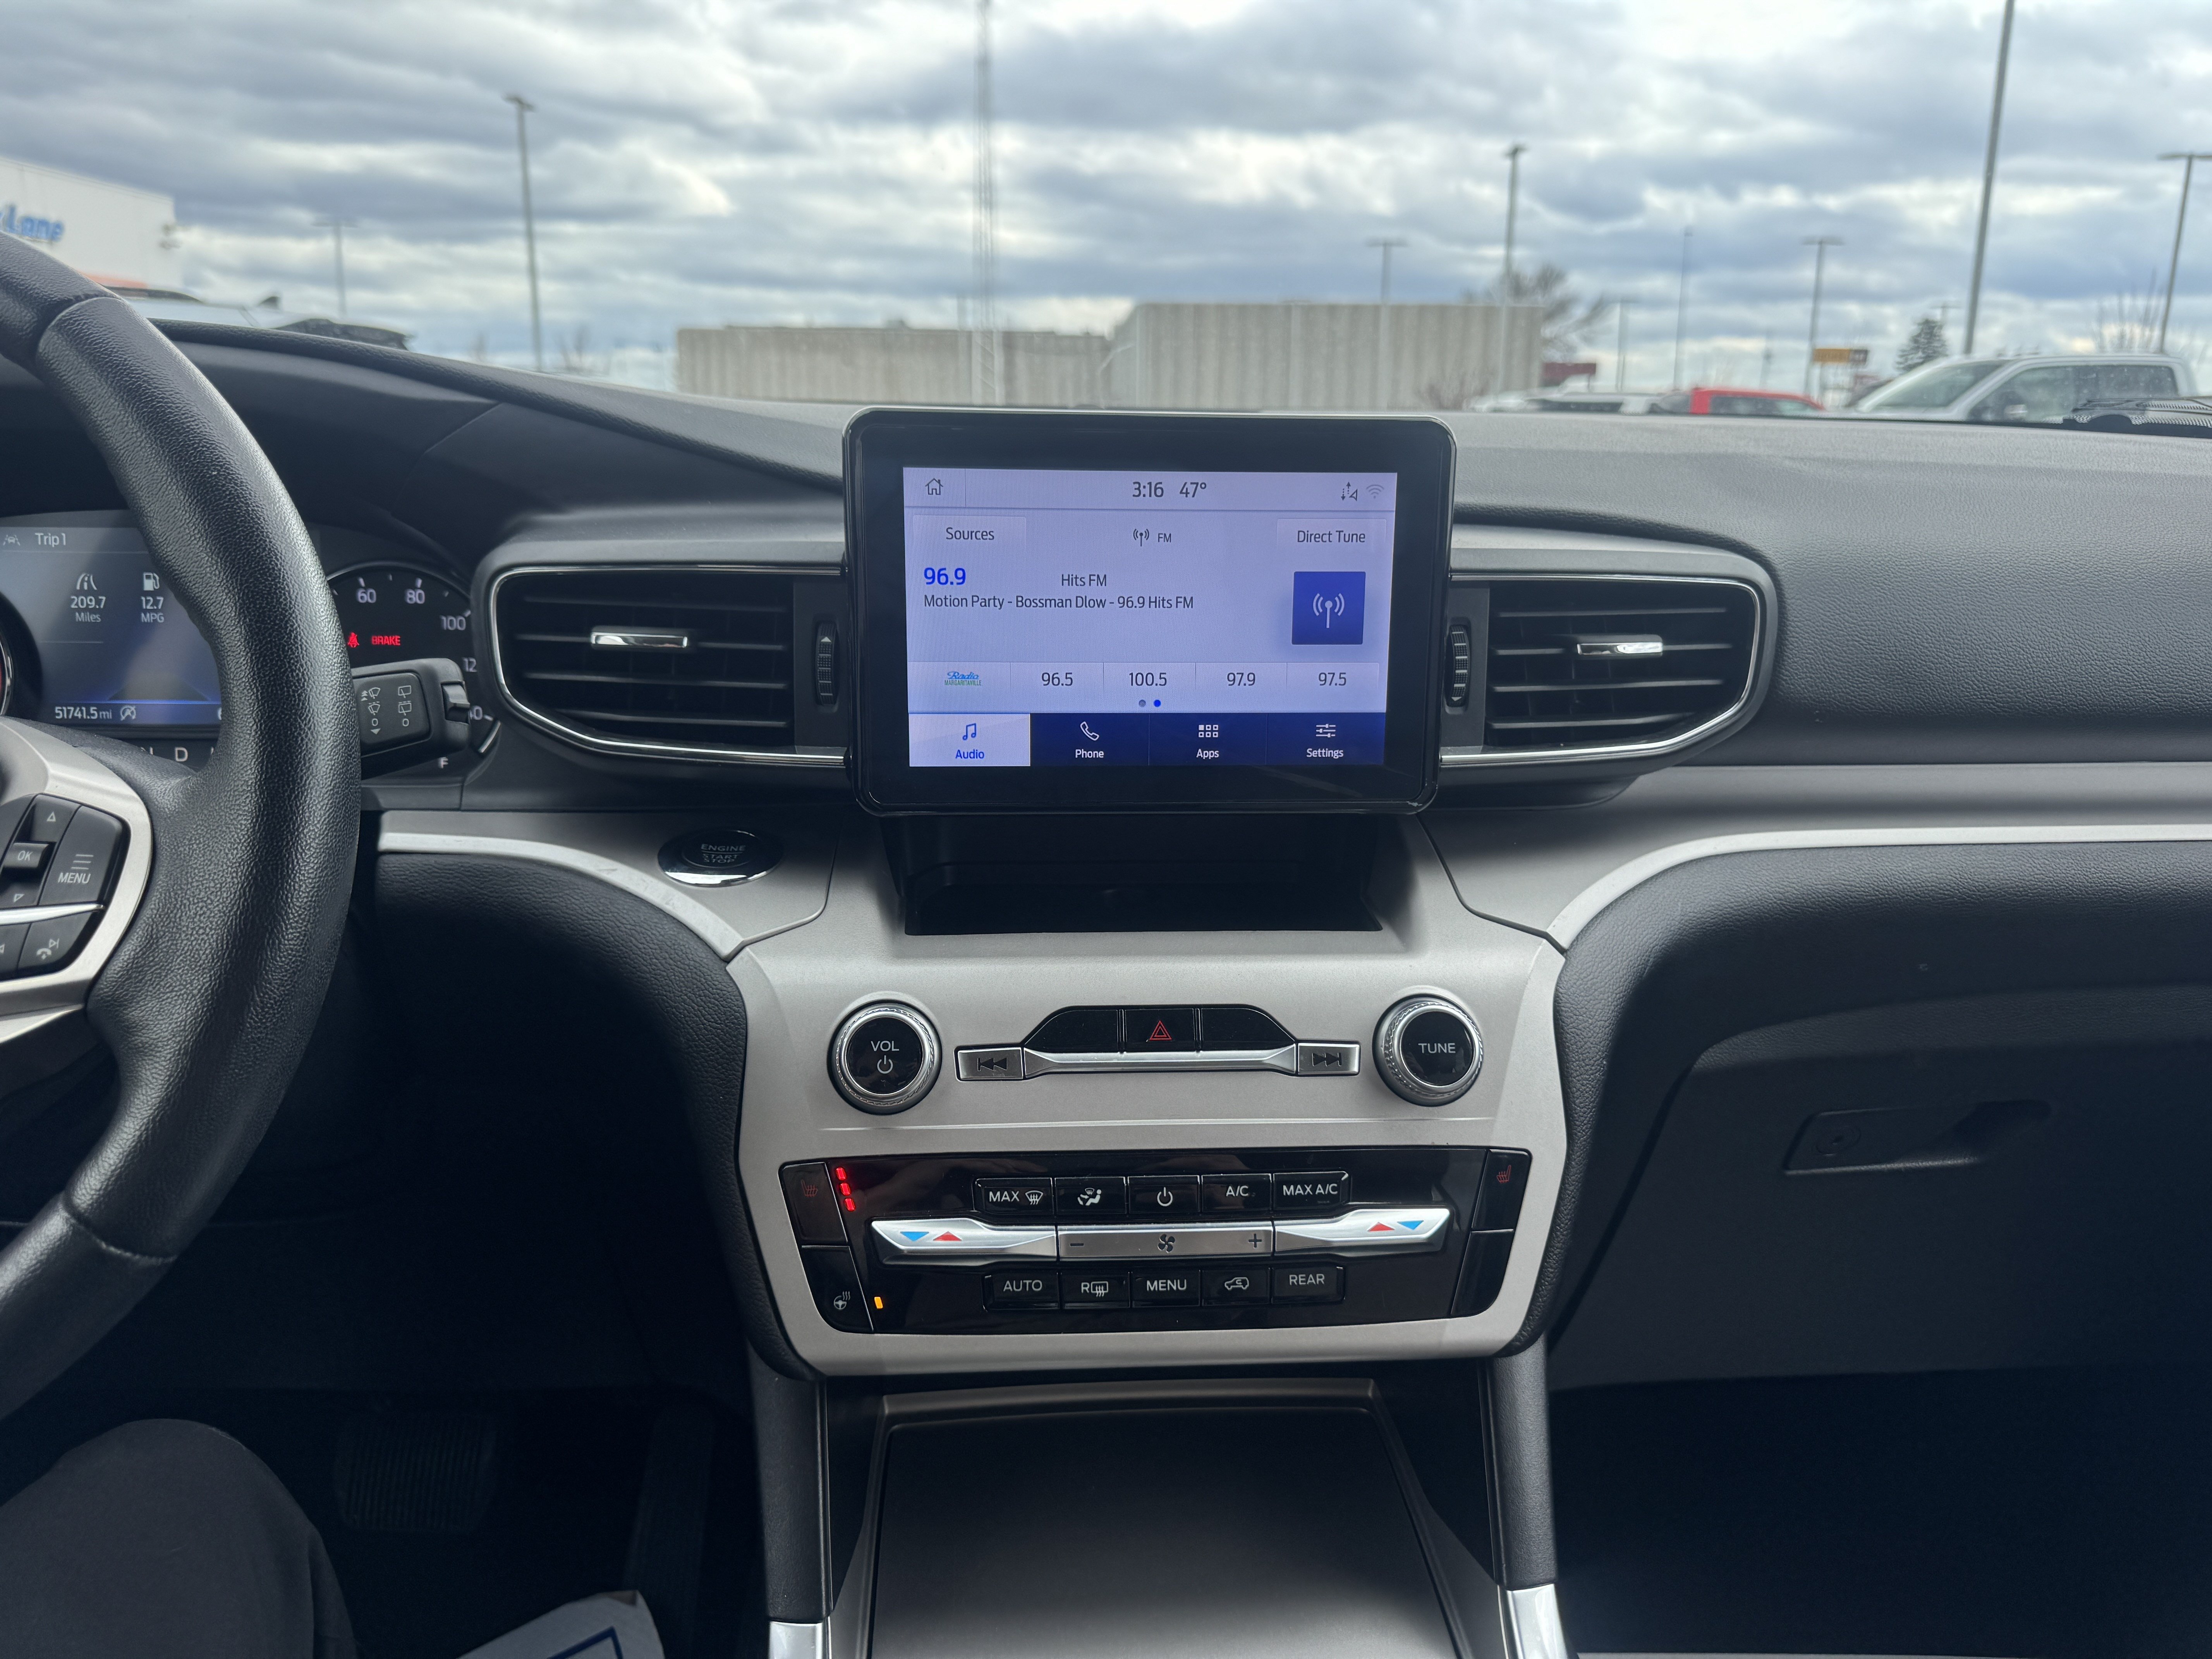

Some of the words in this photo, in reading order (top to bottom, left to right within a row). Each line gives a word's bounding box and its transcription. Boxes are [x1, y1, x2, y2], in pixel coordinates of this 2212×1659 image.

[1132, 481, 1164, 498] 3:16
[1179, 482, 1207, 498] 47°
[946, 527, 994, 540] Sources
[1158, 533, 1171, 543] FM
[1297, 530, 1333, 543] Direct
[1335, 530, 1365, 543] Tune
[924, 567, 966, 586] 96.9
[1061, 574, 1086, 586] Hits
[1089, 574, 1107, 587] FM
[70, 595, 106, 608] 209.7
[357, 589, 376, 603] 60
[406, 589, 425, 604] 80
[924, 594, 968, 607] Motion
[971, 595, 1005, 610] Party
[1016, 595, 1072, 608] Bossman
[1075, 595, 1106, 608] Dlow
[1118, 596, 1145, 608] 96.9
[1149, 596, 1173, 608] Hits
[1176, 596, 1193, 608] FM
[141, 596, 164, 609] 12.7
[75, 611, 101, 622] Miles
[141, 612, 165, 623] MPG
[441, 616, 465, 630] 100
[371, 635, 400, 646] BRAKE
[947, 671, 979, 679] Radio
[1041, 672, 1073, 686] 96.5
[1129, 672, 1167, 686] 100.5
[1227, 672, 1255, 686] 97.9
[1318, 672, 1346, 686] 97.5
[55, 706, 98, 719] 51741.5
[99, 709, 112, 719] mi
[175, 747, 188, 762] D
[955, 749, 984, 759] Audio
[1075, 749, 1104, 758] Phone
[1196, 749, 1219, 759] Apps
[1306, 748, 1344, 759] Settings
[17, 850, 33, 861] OK
[58, 872, 91, 884] MENU
[871, 1041, 900, 1051] VOL
[1418, 1042, 1456, 1053] TUNE
[1226, 1185, 1249, 1197] A/C
[1283, 1184, 1313, 1195] MAX
[1315, 1183, 1338, 1195] A/C
[989, 1191, 1020, 1202] MAX
[1003, 1279, 1042, 1291] AUTO
[1147, 1279, 1187, 1291] MENU
[1289, 1273, 1325, 1285] REAR
